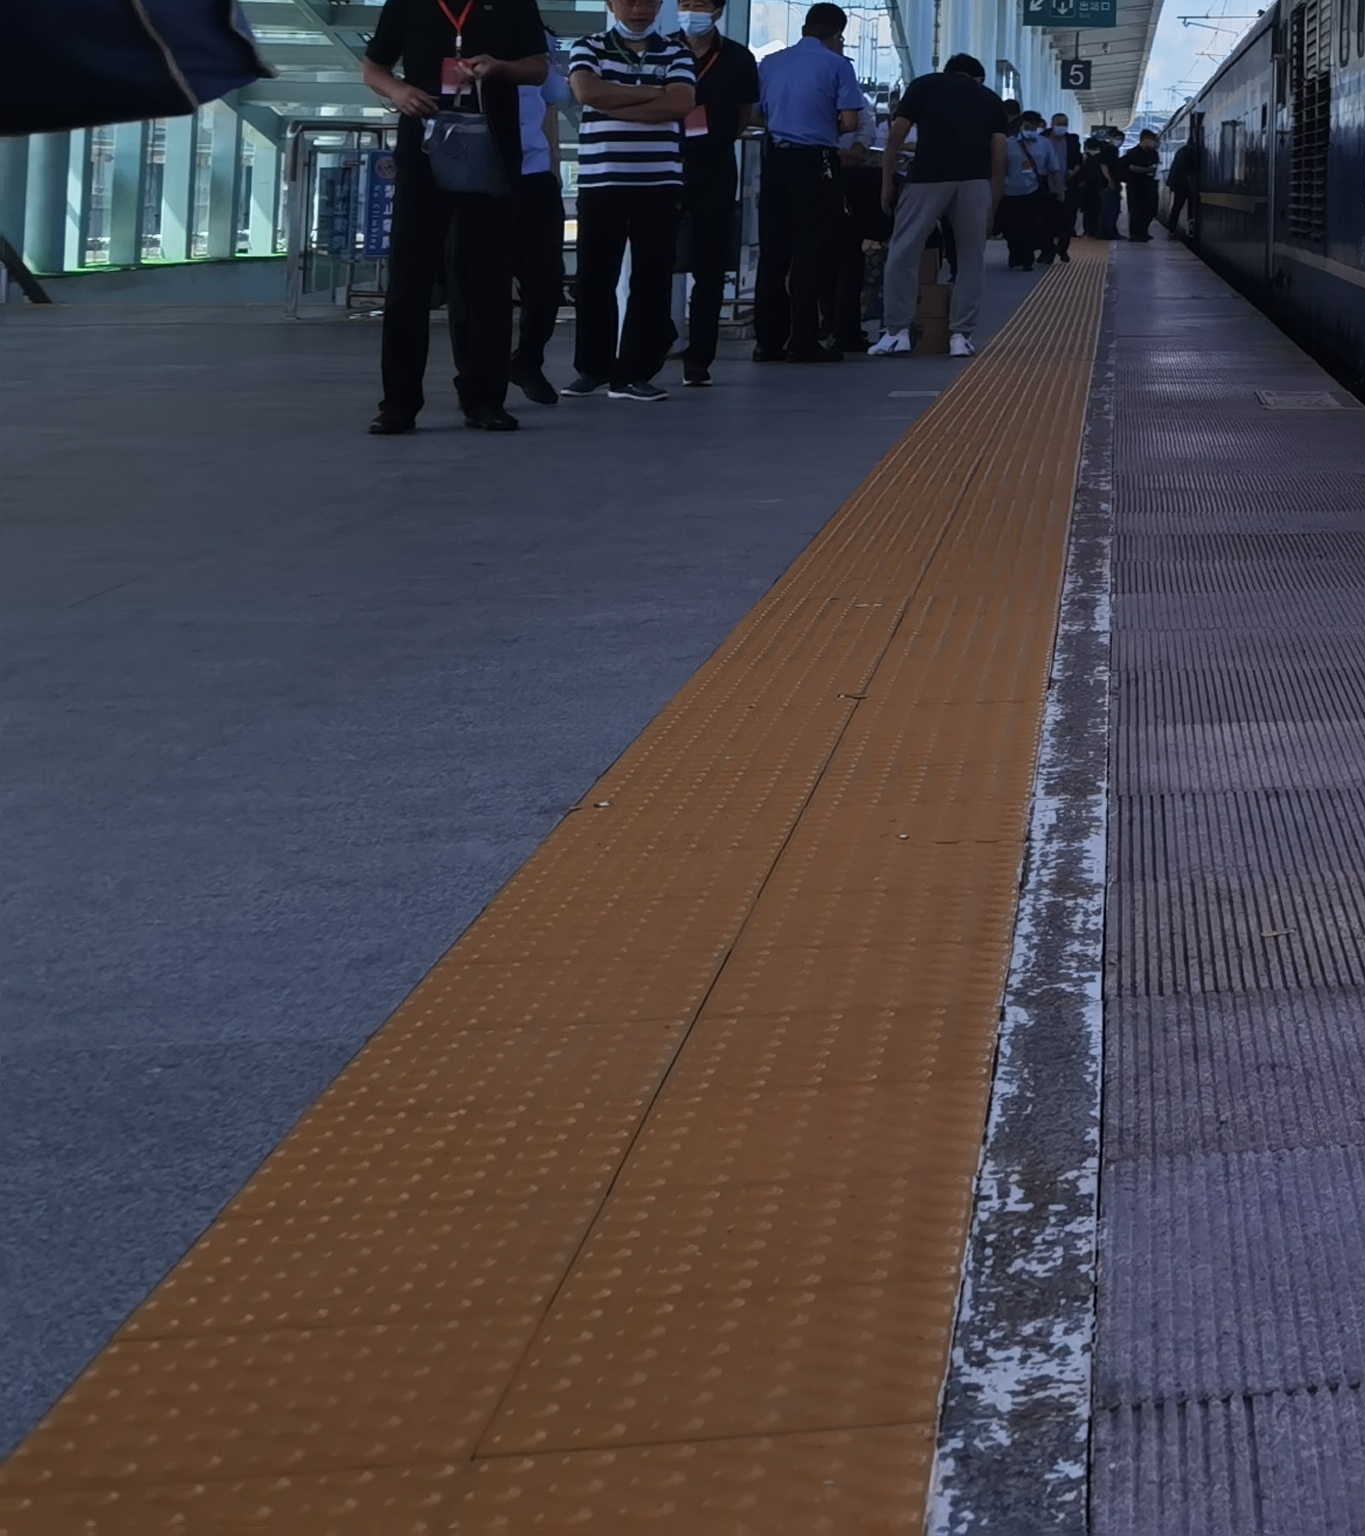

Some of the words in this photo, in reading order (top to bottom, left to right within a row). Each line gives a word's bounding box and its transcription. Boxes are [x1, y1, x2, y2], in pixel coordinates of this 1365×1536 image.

[1079, 1, 1110, 12] 出站口
[1069, 64, 1084, 85] 5
